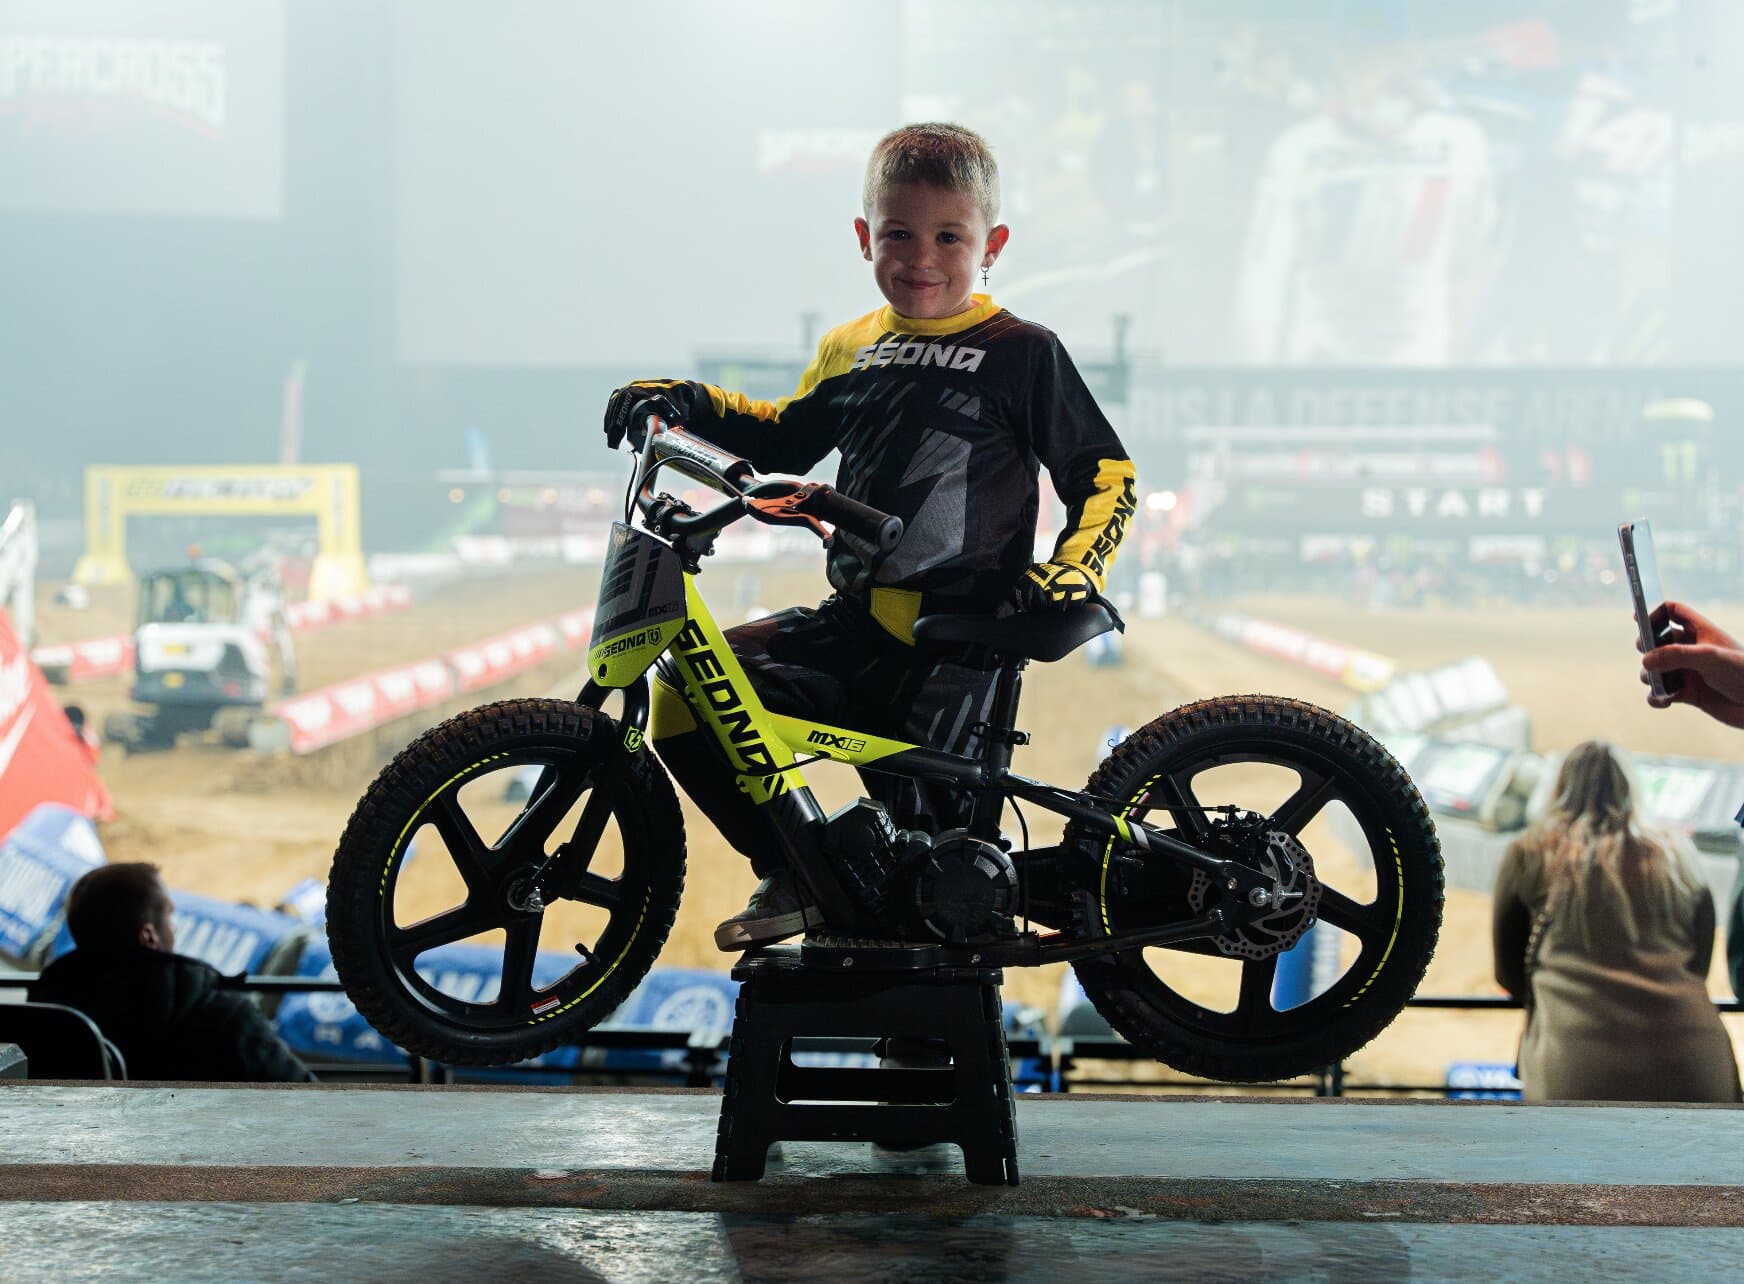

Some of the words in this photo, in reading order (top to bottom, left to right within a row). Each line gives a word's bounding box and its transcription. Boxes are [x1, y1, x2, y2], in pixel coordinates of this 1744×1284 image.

[0, 36, 226, 126] PERCROSS
[851, 342, 987, 373] SEONA
[1361, 487, 1547, 518] START
[676, 619, 777, 776] SEONA
[807, 729, 867, 753] MX16
